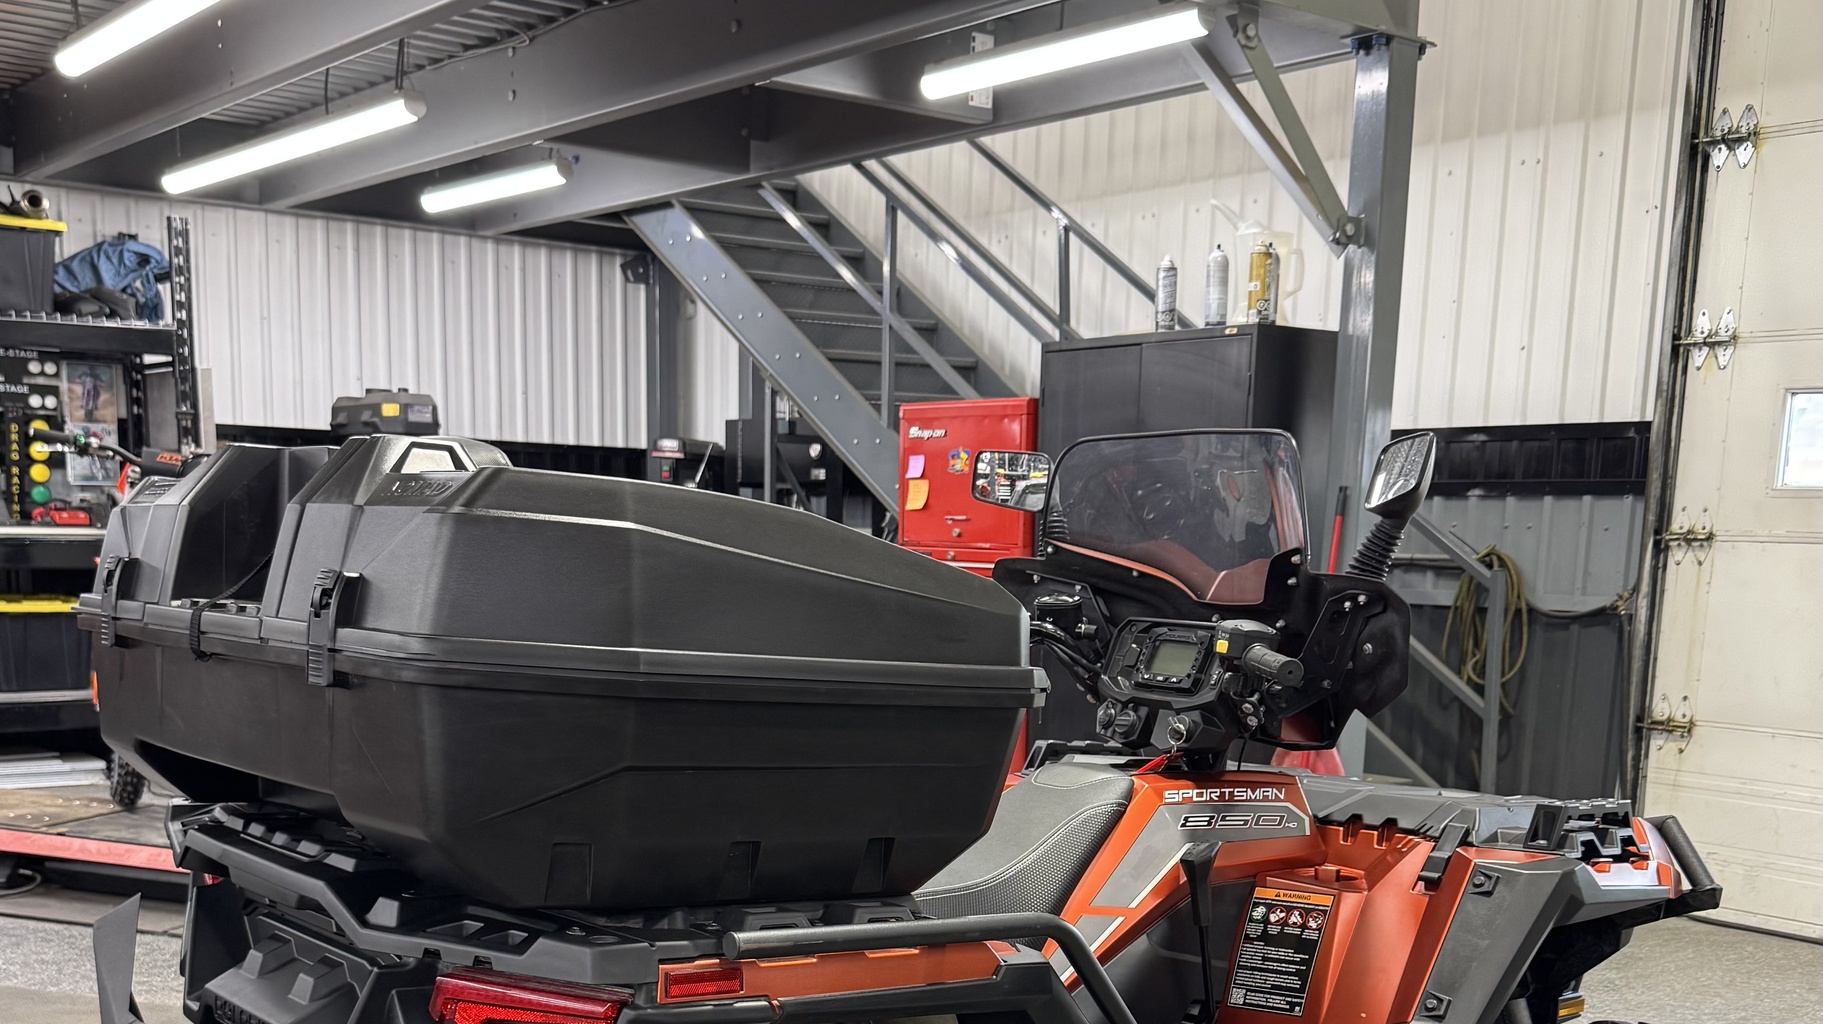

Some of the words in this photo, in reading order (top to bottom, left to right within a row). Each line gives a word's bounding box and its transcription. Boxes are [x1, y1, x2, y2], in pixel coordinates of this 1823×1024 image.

[0, 383, 30, 395] STAGE
[9, 422, 20, 461] DRAG
[10, 465, 21, 521] RACING
[1164, 788, 1286, 803] SPORTSMAN
[1177, 812, 1287, 830] 850
[1282, 892, 1311, 901] WARNING
